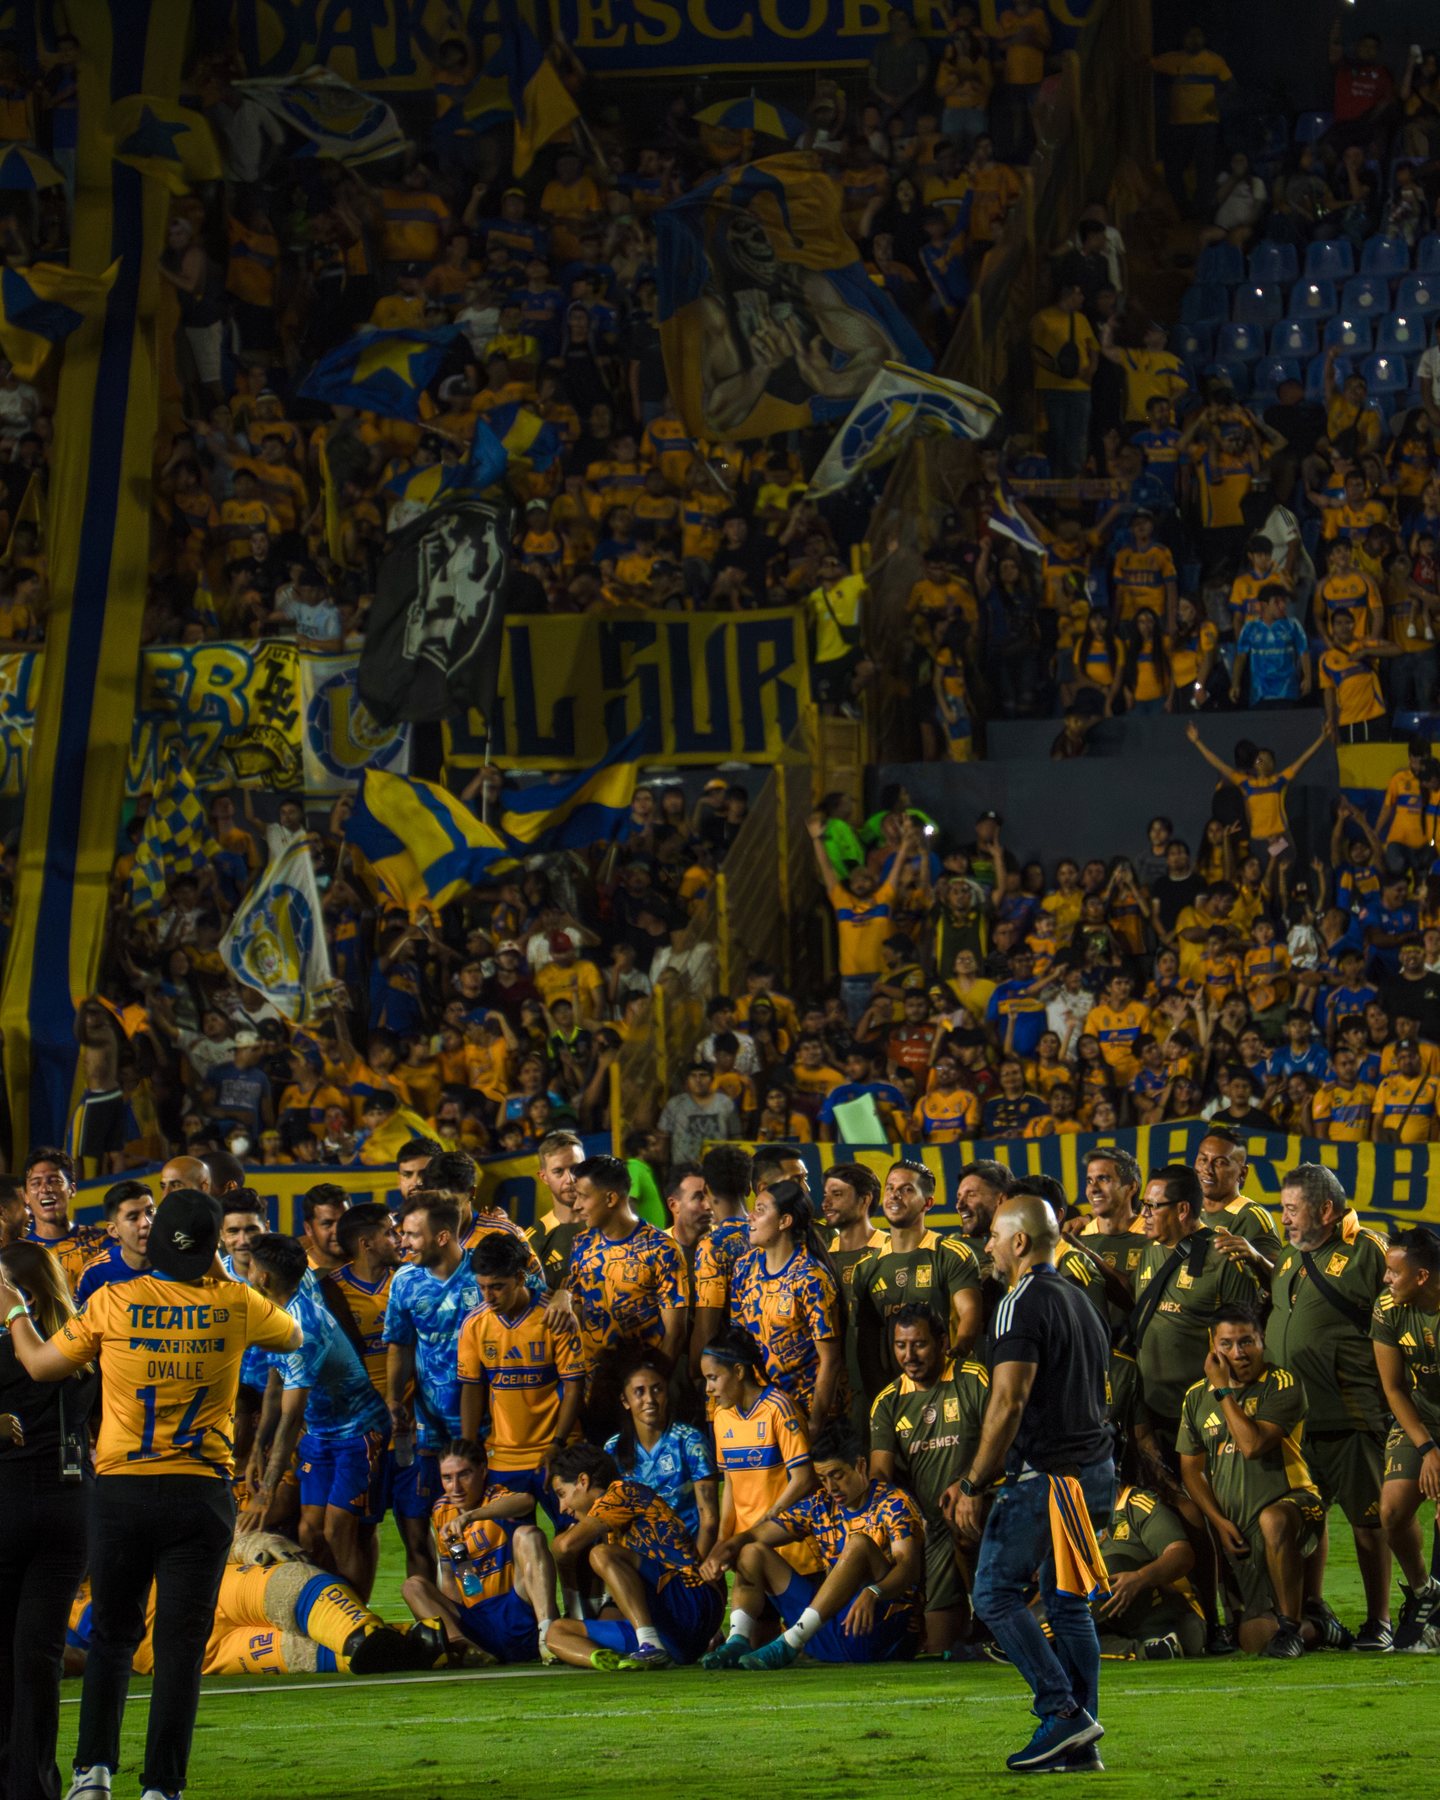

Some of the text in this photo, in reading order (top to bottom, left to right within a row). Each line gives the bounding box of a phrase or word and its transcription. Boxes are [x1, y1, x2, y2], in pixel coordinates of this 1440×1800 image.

[127, 1304, 212, 1329] TECATE
[158, 1339, 221, 1353] AFIRME
[147, 1360, 204, 1380] OVALLE
[501, 1374, 543, 1386] CEMEX
[920, 1434, 960, 1451] CEMEX
